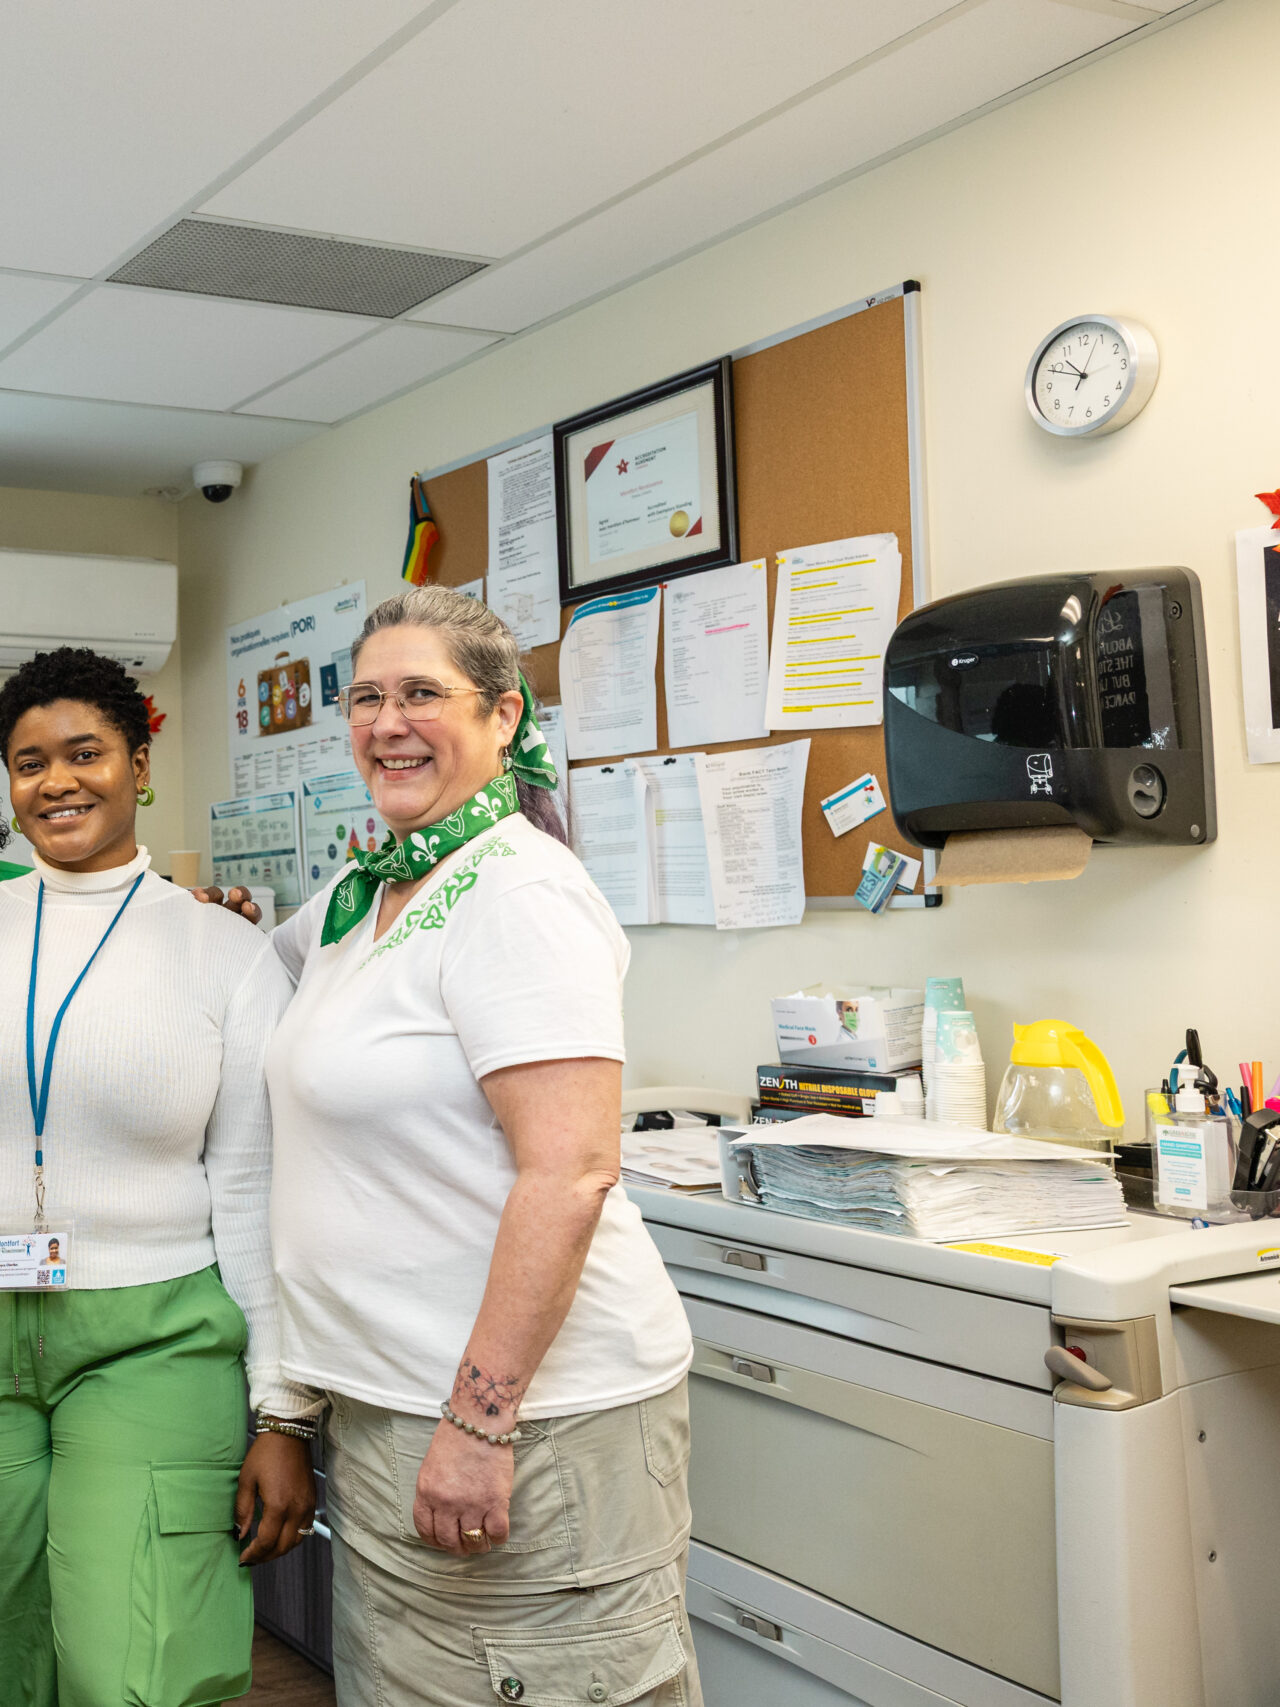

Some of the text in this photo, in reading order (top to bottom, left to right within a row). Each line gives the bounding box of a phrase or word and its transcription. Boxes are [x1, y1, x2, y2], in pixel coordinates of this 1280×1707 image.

[1078, 334, 1089, 346] 12
[1100, 334, 1104, 344] 1
[1063, 345, 1072, 357] 11
[1113, 344, 1120, 354] 2
[1120, 358, 1127, 370] 3
[1046, 382, 1052, 393] 9
[1116, 380, 1122, 390] 4
[1054, 399, 1060, 410] 8
[1104, 396, 1110, 407] 5
[1068, 406, 1074, 418] 7
[1086, 407, 1092, 417] 6
[290, 616, 316, 638] (POR)
[238, 678, 246, 698] 6
[236, 709, 248, 729] 18
[799, 1082, 820, 1093] NITRILE
[821, 1084, 858, 1096] DISPOSABLE
